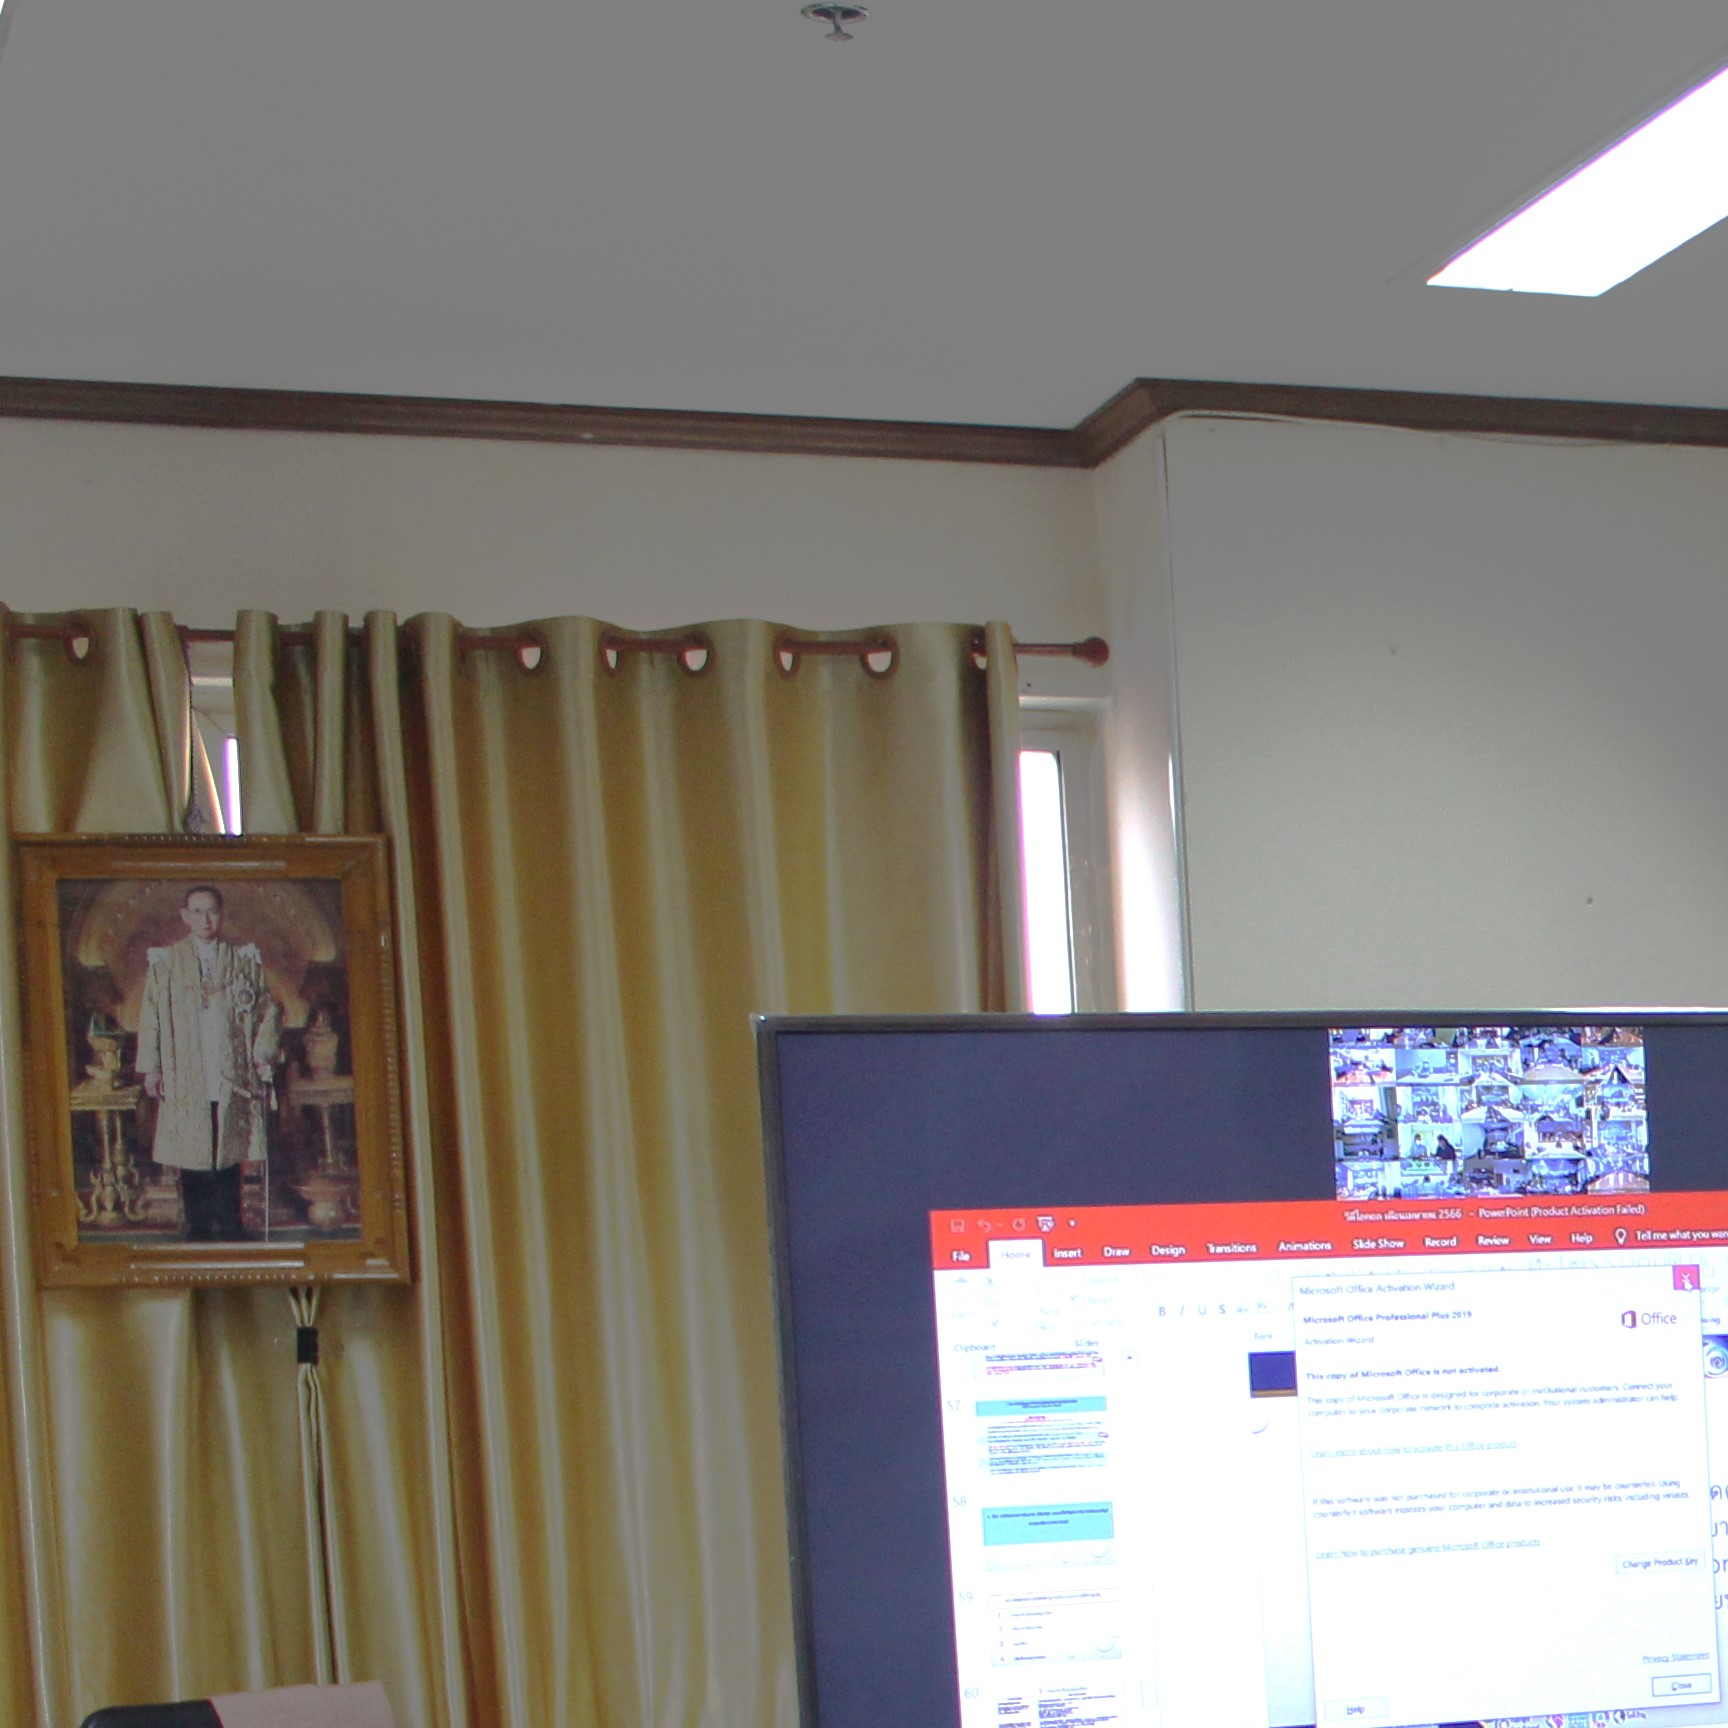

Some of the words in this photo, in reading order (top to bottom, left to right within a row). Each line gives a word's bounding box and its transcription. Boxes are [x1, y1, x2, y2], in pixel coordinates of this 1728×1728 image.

[1438, 1208, 1463, 1219] 2566
[1478, 1207, 1529, 1218] PowerPoint
[1532, 1205, 1569, 1218] (Product
[1570, 1205, 1614, 1216] Activation
[1616, 1204, 1645, 1216] Failed)
[1425, 1236, 1457, 1247] Record
[1478, 1235, 1509, 1246] Review
[1529, 1234, 1552, 1245] View
[1571, 1233, 1593, 1245] Help
[1636, 1231, 1652, 1241] Tell
[1669, 1229, 1692, 1239] what
[1693, 1231, 1710, 1242] you
[1206, 1242, 1257, 1254] Transitions
[1279, 1240, 1332, 1251] Animations
[1353, 1239, 1375, 1249] Slide
[1378, 1238, 1405, 1248] Show
[952, 1251, 970, 1262] File
[1001, 1250, 1031, 1259] Home
[1054, 1247, 1082, 1258] Insert
[1103, 1246, 1131, 1257] Draw
[1151, 1244, 1186, 1257] Design
[1299, 1284, 1344, 1296] Microsoft
[1346, 1283, 1374, 1294] Office
[1376, 1282, 1422, 1293] Activation
[1424, 1281, 1456, 1292] Wizard
[1303, 1315, 1345, 1325] Microsoft
[1347, 1313, 1374, 1323] Office
[1376, 1311, 1429, 1322] Professional
[1431, 1310, 1450, 1320] Plus
[1452, 1309, 1473, 1319] 2019
[1640, 1311, 1678, 1326] Office
[1304, 1336, 1344, 1347] Activation
[1346, 1335, 1375, 1345] Wizard
[954, 1343, 996, 1353] Clipboard
[1306, 1372, 1324, 1381] This
[1326, 1372, 1347, 1382] copy
[1361, 1368, 1403, 1379] Microsoft
[1404, 1367, 1432, 1377] Office
[1459, 1364, 1501, 1375] activated.
[1308, 1395, 1323, 1405] This
[1325, 1395, 1345, 1406] copy
[1357, 1393, 1395, 1403] Microsoft
[1397, 1392, 1420, 1402] Office
[1431, 1390, 1467, 1402] designed
[1482, 1389, 1520, 1399] corporate
[1531, 1386, 1577, 1395] institutional
[1622, 1382, 1654, 1392] Connect
[1656, 1382, 1673, 1393] your
[1308, 1408, 1346, 1419] computer
[1379, 1405, 1418, 1416] corporate
[1420, 1403, 1452, 1413] network
[1464, 1401, 1500, 1412] complete
[1563, 1398, 1591, 1408] system
[1461, 1441, 1485, 1451] Office
[1319, 1496, 1335, 1506] this
[1336, 1495, 1372, 1505] software
[1405, 1492, 1448, 1503] purchased
[1461, 1489, 1501, 1500] corporate
[1584, 1483, 1601, 1493] may
[1658, 1478, 1681, 1490] Using
[1312, 1509, 1358, 1519] counterfeit
[1358, 1507, 1393, 1517] software
[1394, 1506, 1427, 1516] exposes
[1428, 1504, 1447, 1514] your
[1448, 1501, 1487, 1513] computer
[1504, 1499, 1523, 1509] data
[1534, 1496, 1571, 1507] increased
[1572, 1494, 1602, 1506] security
[1625, 1491, 1661, 1503] including
[1340, 1548, 1358, 1558] how
[1370, 1545, 1407, 1557] purchase
[1442, 1541, 1480, 1552] Microsoft
[1481, 1539, 1505, 1550] Office
[1506, 1538, 1541, 1550] products
[1622, 1560, 1652, 1570] Change
[1653, 1558, 1683, 1568] Product
[1642, 1654, 1670, 1664] Privacy
[964, 1687, 979, 1699] 60
[1347, 1704, 1365, 1716] Help
